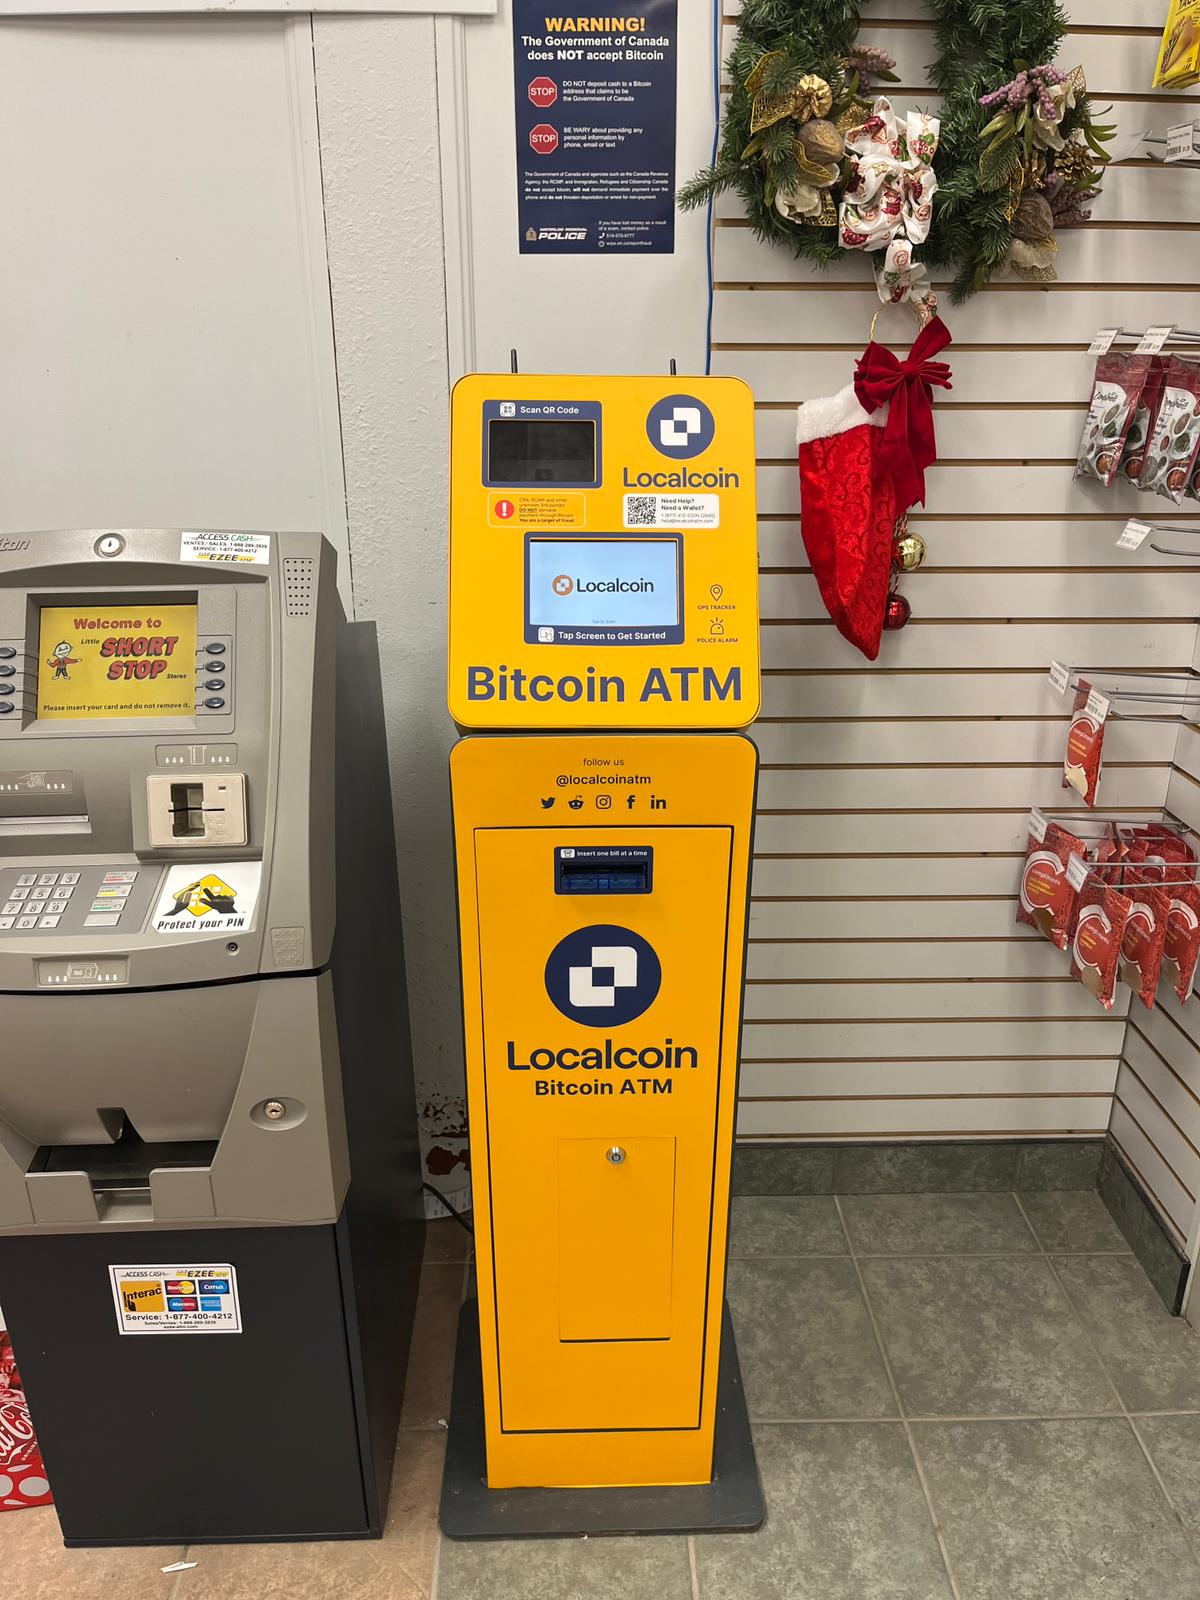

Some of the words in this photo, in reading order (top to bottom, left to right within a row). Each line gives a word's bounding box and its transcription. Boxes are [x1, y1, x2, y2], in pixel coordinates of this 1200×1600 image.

[545, 17, 646, 32] WARNING!
[522, 36, 542, 46] The
[545, 36, 612, 46] Government
[615, 36, 625, 46] of
[628, 36, 669, 46] Canada
[528, 50, 554, 60] does
[557, 50, 584, 60] NOT
[586, 52, 623, 62] accept
[626, 50, 664, 60] Bitcoin
[530, 87, 555, 96] STOP
[531, 134, 556, 143] STOP
[538, 232, 587, 240] POLICE
[520, 405, 541, 414] Scan
[543, 405, 555, 415] QR
[557, 405, 579, 414] Code
[623, 467, 739, 488] Localcoin
[197, 533, 230, 541] ACCESS
[209, 554, 239, 562] EZEE
[577, 577, 654, 593] Localcoin
[74, 618, 142, 630] Welcome
[146, 617, 162, 629] to
[558, 632, 573, 641] Tap
[576, 632, 605, 640] Screen
[607, 632, 615, 640] to
[617, 632, 632, 640] Get
[100, 636, 179, 657] SHORT
[107, 660, 168, 680] STOP
[467, 665, 625, 703] Bitcoin
[639, 667, 742, 702] ATM
[87, 704, 103, 712] your
[133, 702, 143, 710] do
[156, 702, 181, 710] remove
[583, 758, 610, 766] follow
[556, 774, 651, 787] @localcoinatm
[65, 876, 73, 884] 3
[9, 905, 16, 913] 7
[30, 905, 37, 913] 8
[52, 904, 59, 912] 9
[157, 919, 196, 930] Protect
[200, 919, 223, 930] your
[226, 917, 245, 927] PIN
[507, 1038, 698, 1071] Localcoin
[535, 1079, 613, 1096] Bitcoin
[619, 1079, 673, 1094] ATM
[187, 1270, 215, 1278] EZEE
[123, 1287, 162, 1301] Interac
[125, 1313, 162, 1321] Service:
